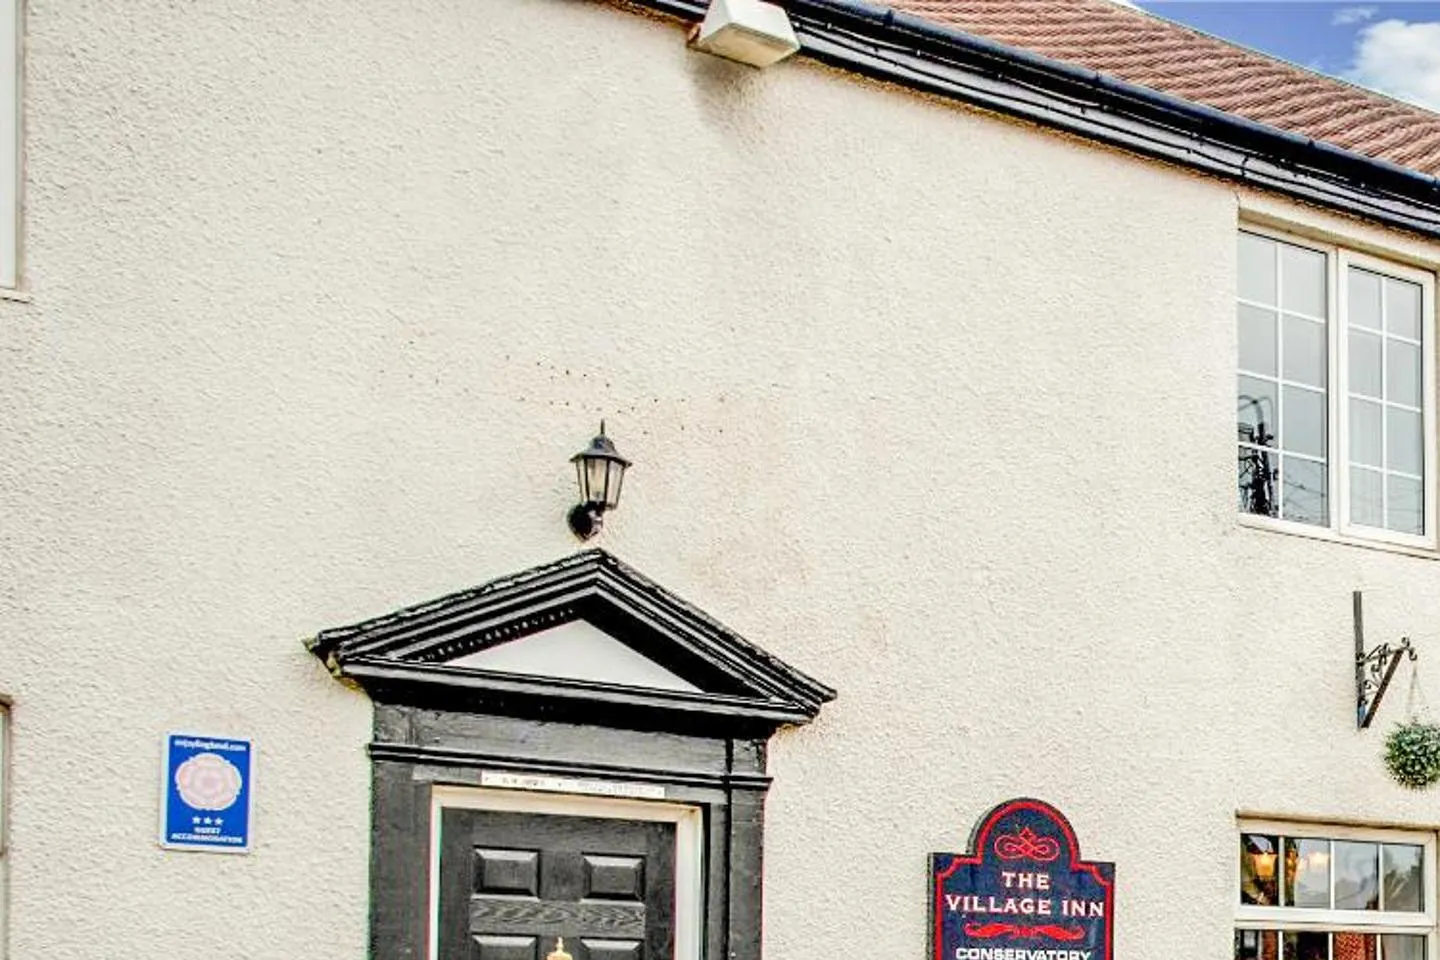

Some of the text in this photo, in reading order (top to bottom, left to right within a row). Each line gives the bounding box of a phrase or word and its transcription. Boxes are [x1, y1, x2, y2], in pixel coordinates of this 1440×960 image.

[1001, 871, 1050, 890] THE
[945, 895, 1104, 917] VILLAGE INN
